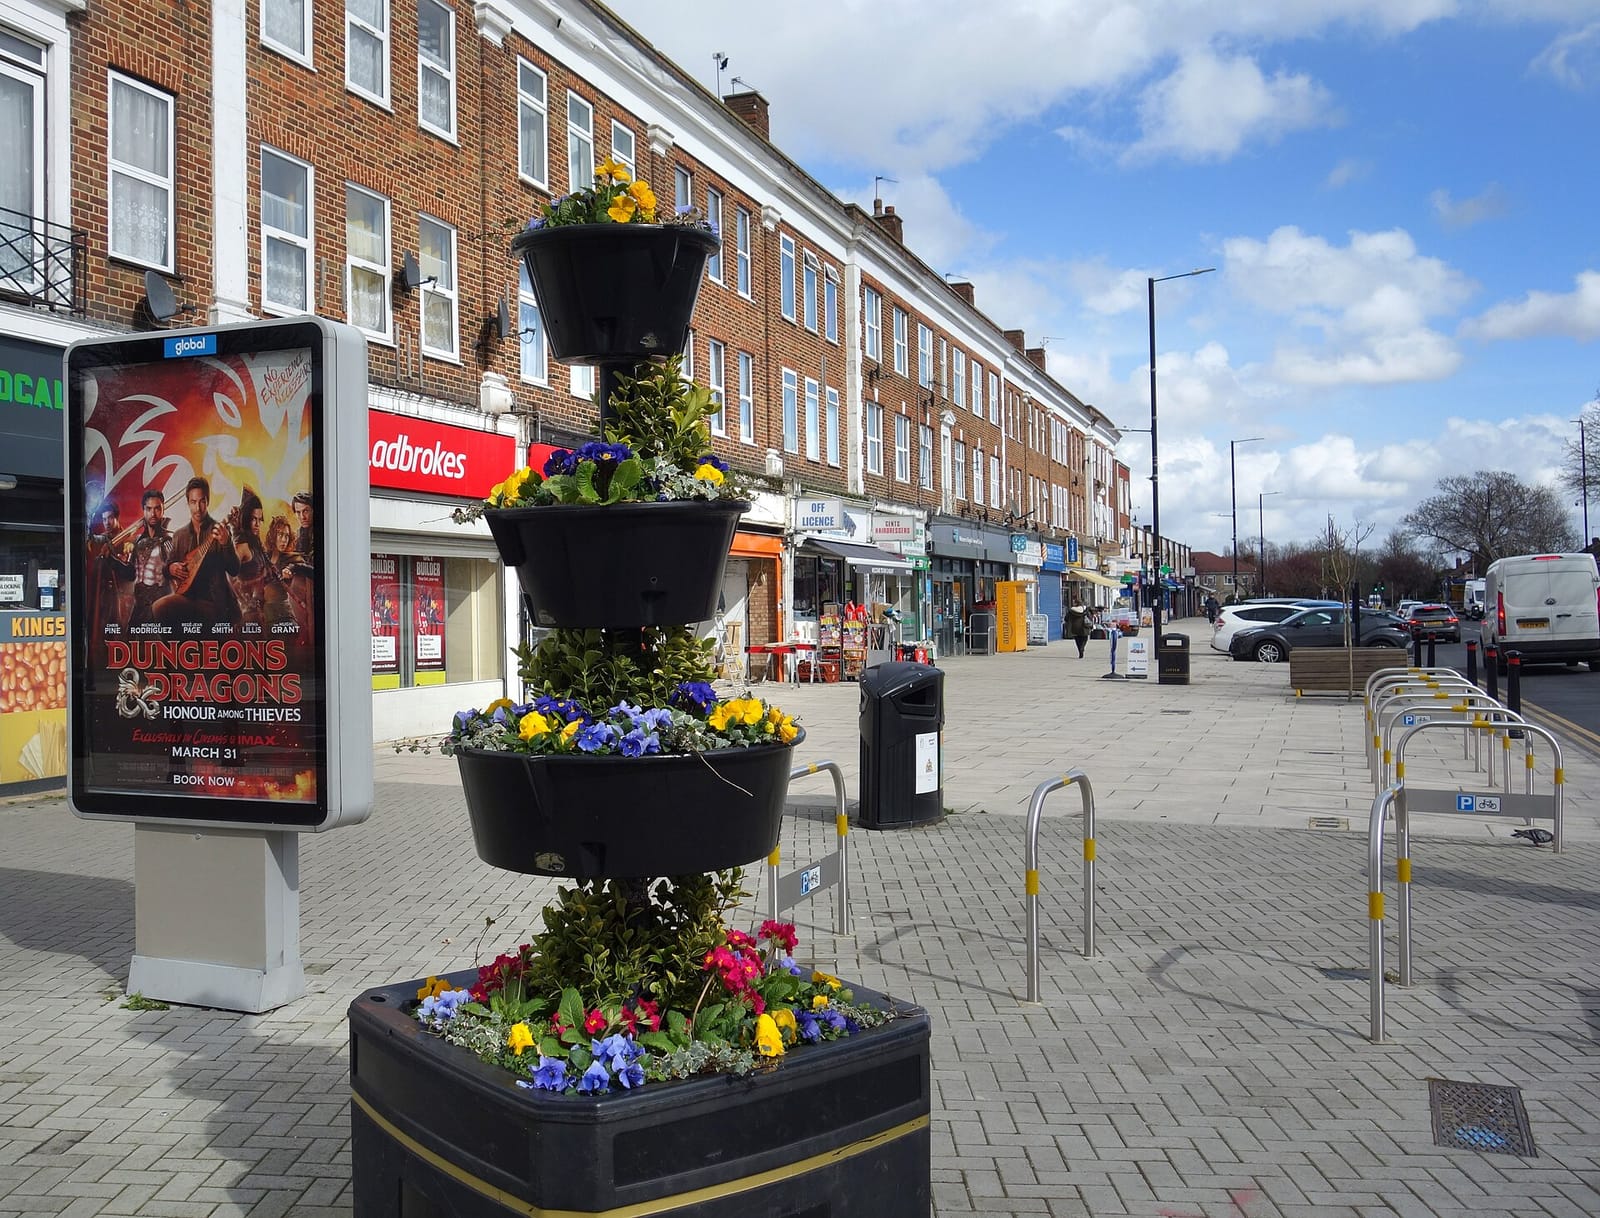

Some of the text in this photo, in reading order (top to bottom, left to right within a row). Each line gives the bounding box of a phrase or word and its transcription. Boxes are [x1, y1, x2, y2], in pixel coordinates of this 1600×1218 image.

[175, 336, 206, 356] global
[263, 364, 278, 389] NO
[368, 433, 467, 479] adbrokes
[811, 502, 826, 513] OFF
[802, 516, 835, 527] LICENCE
[416, 561, 441, 576] BUILDER
[12, 616, 66, 638] KINGS
[130, 626, 172, 634] RODRIGUEZ
[183, 626, 201, 634] PAGE
[211, 626, 234, 634] SMITH
[241, 626, 262, 634] LILLIS
[271, 625, 300, 634] GRANT
[104, 640, 288, 671] DUNGEONS
[144, 671, 303, 704] DRAGONS
[163, 705, 302, 722] HONOUR AMONG THIEVES
[1405, 716, 1413, 724] P
[237, 735, 278, 746] IMAX
[172, 746, 237, 759] MARCH 31
[173, 774, 205, 786] BOOK
[208, 775, 235, 787] NOW
[1460, 797, 1473, 810] P
[801, 871, 809, 895] P
